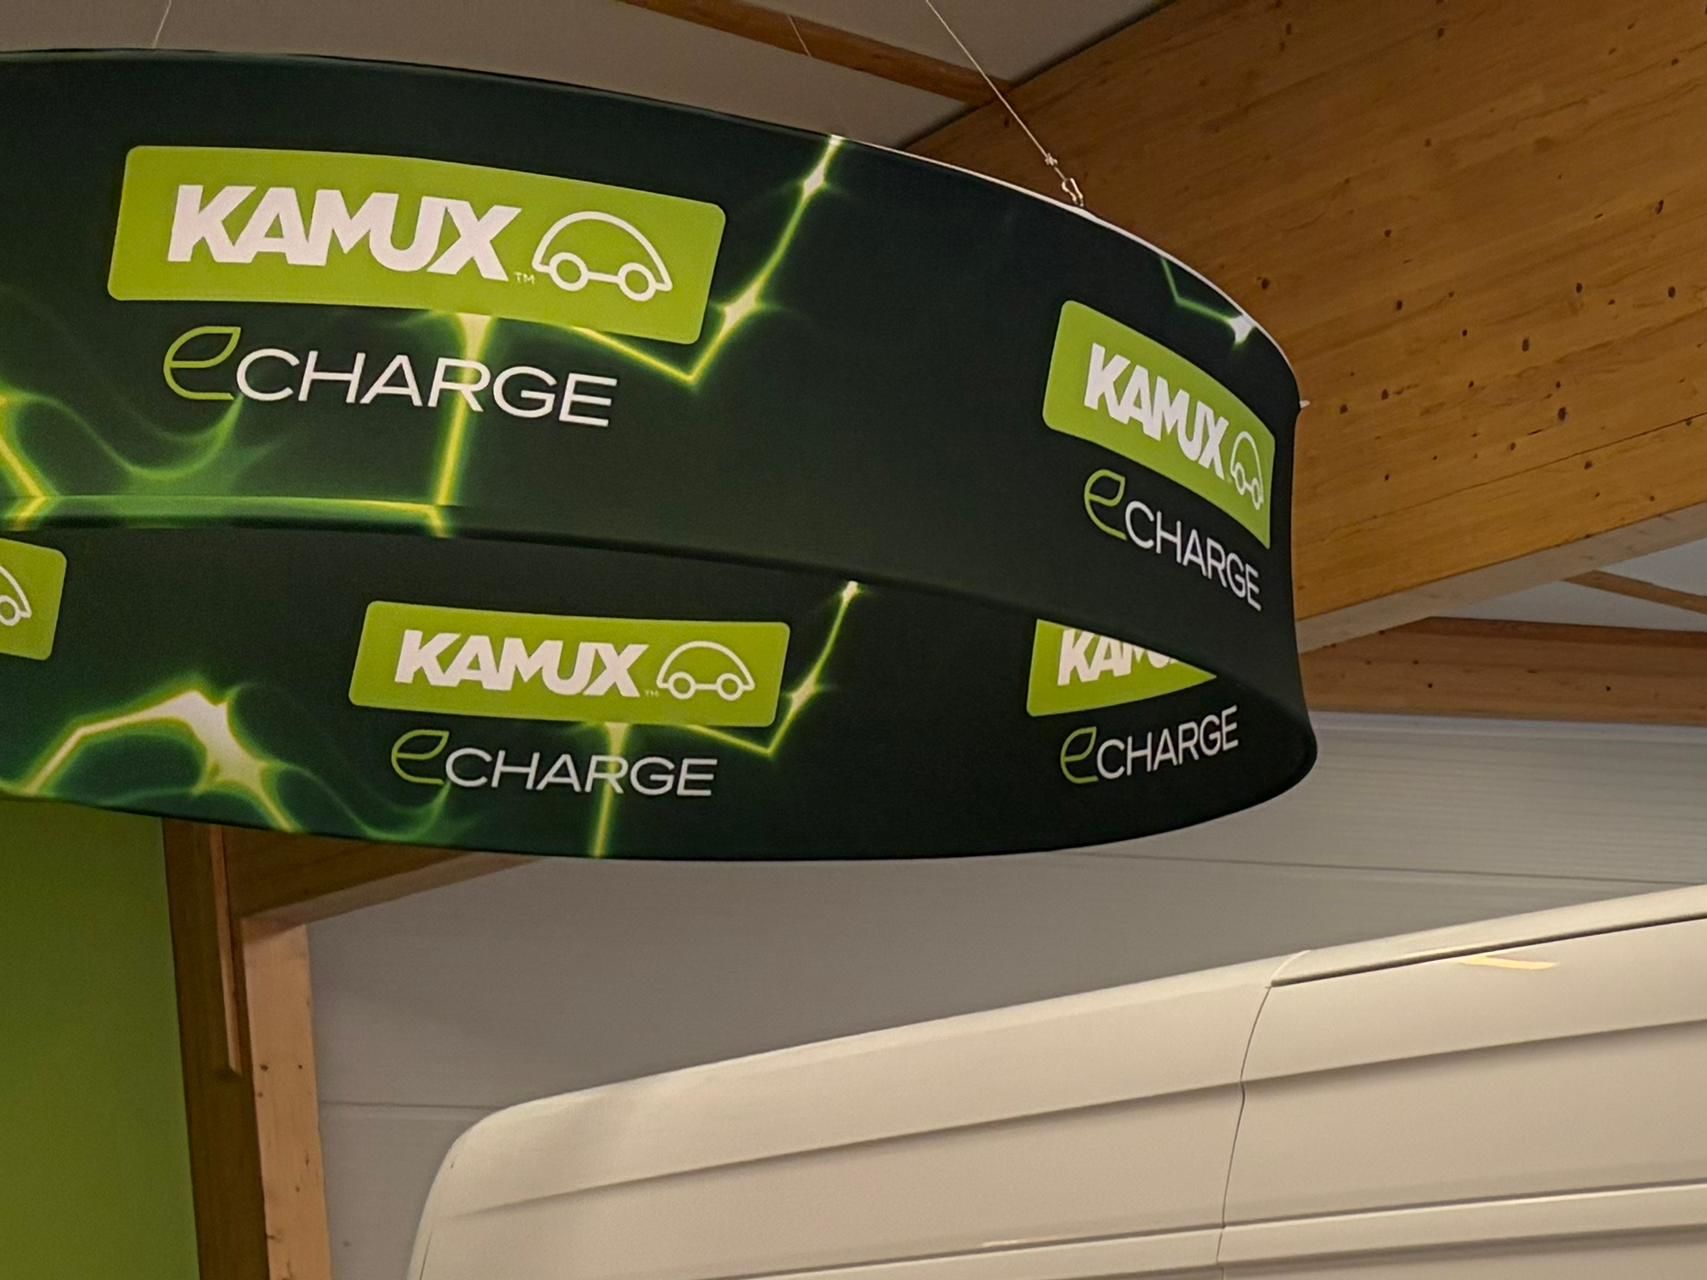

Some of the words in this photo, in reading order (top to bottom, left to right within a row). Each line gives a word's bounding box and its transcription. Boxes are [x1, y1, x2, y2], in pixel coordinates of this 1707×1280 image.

[167, 184, 522, 282] KAMUX
[1084, 342, 1230, 480] KAMUX
[395, 629, 649, 698] KAMUX
[1057, 628, 1178, 686] KAM
